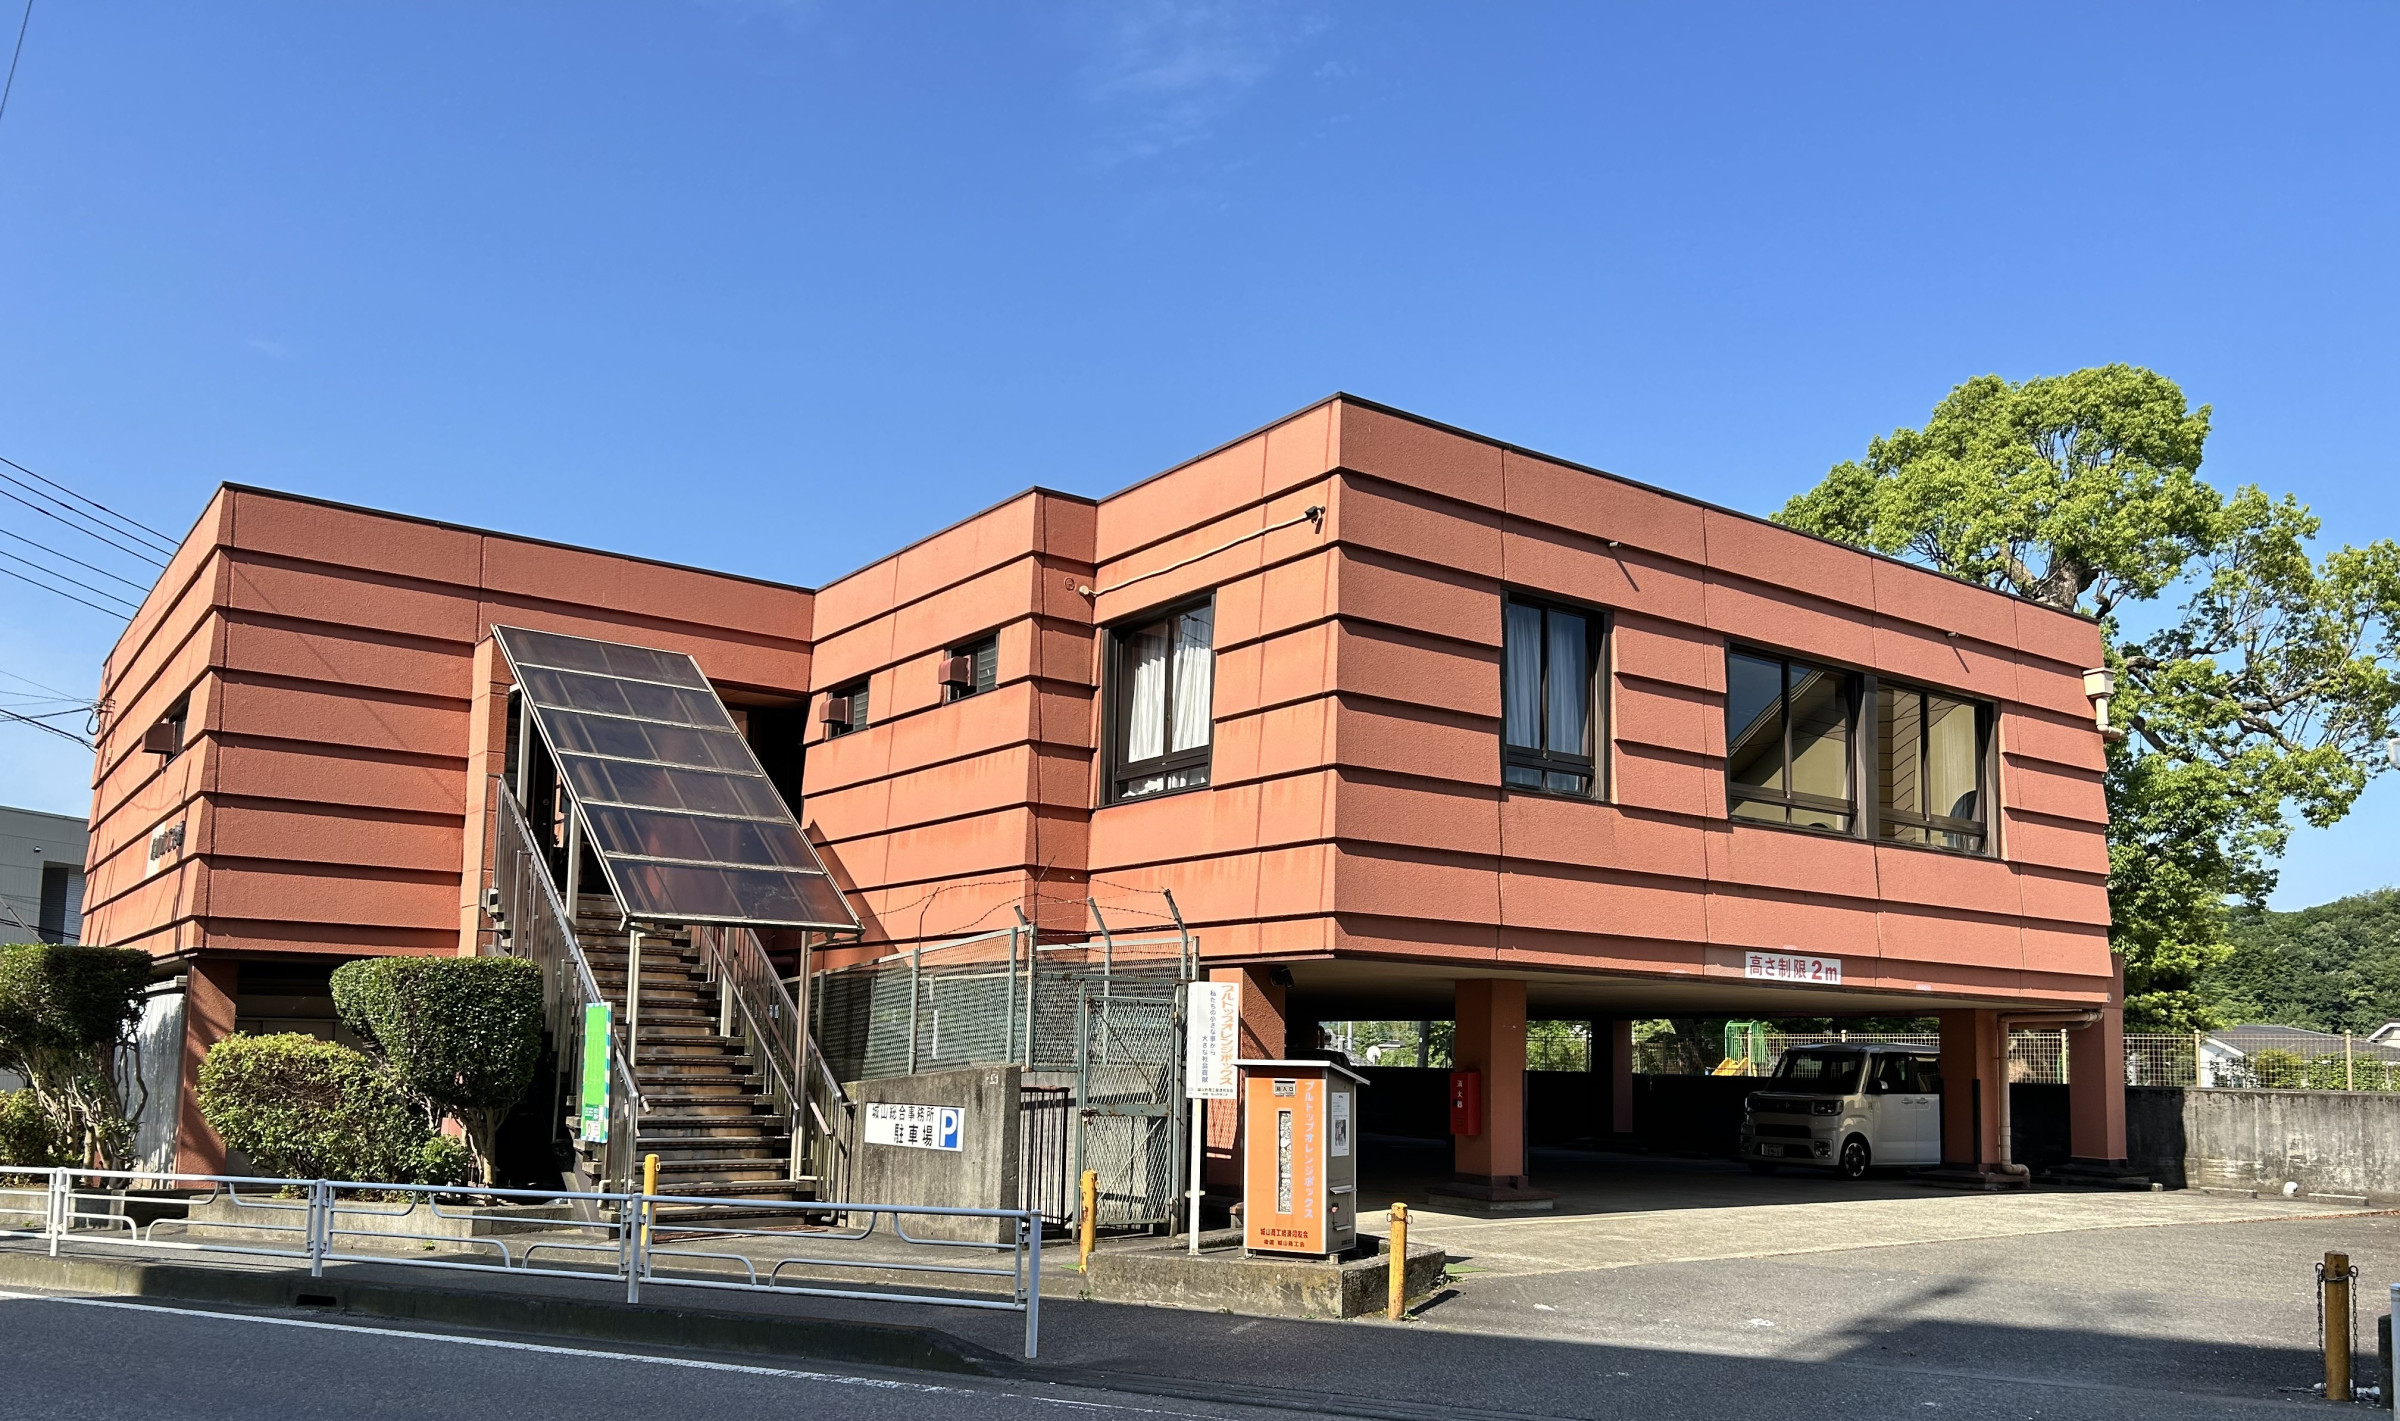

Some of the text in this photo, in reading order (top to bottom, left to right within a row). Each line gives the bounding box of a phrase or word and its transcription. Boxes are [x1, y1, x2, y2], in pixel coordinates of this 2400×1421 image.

[1749, 954, 1838, 982] 高さ制限 2m
[1209, 990, 1217, 1056] 私たちの小さな事から
[1219, 984, 1235, 1086] プルトップオレンジボックス
[872, 1103, 934, 1123] 城山総合事務所
[940, 1110, 958, 1147] P
[894, 1123, 933, 1147] 駐車場
